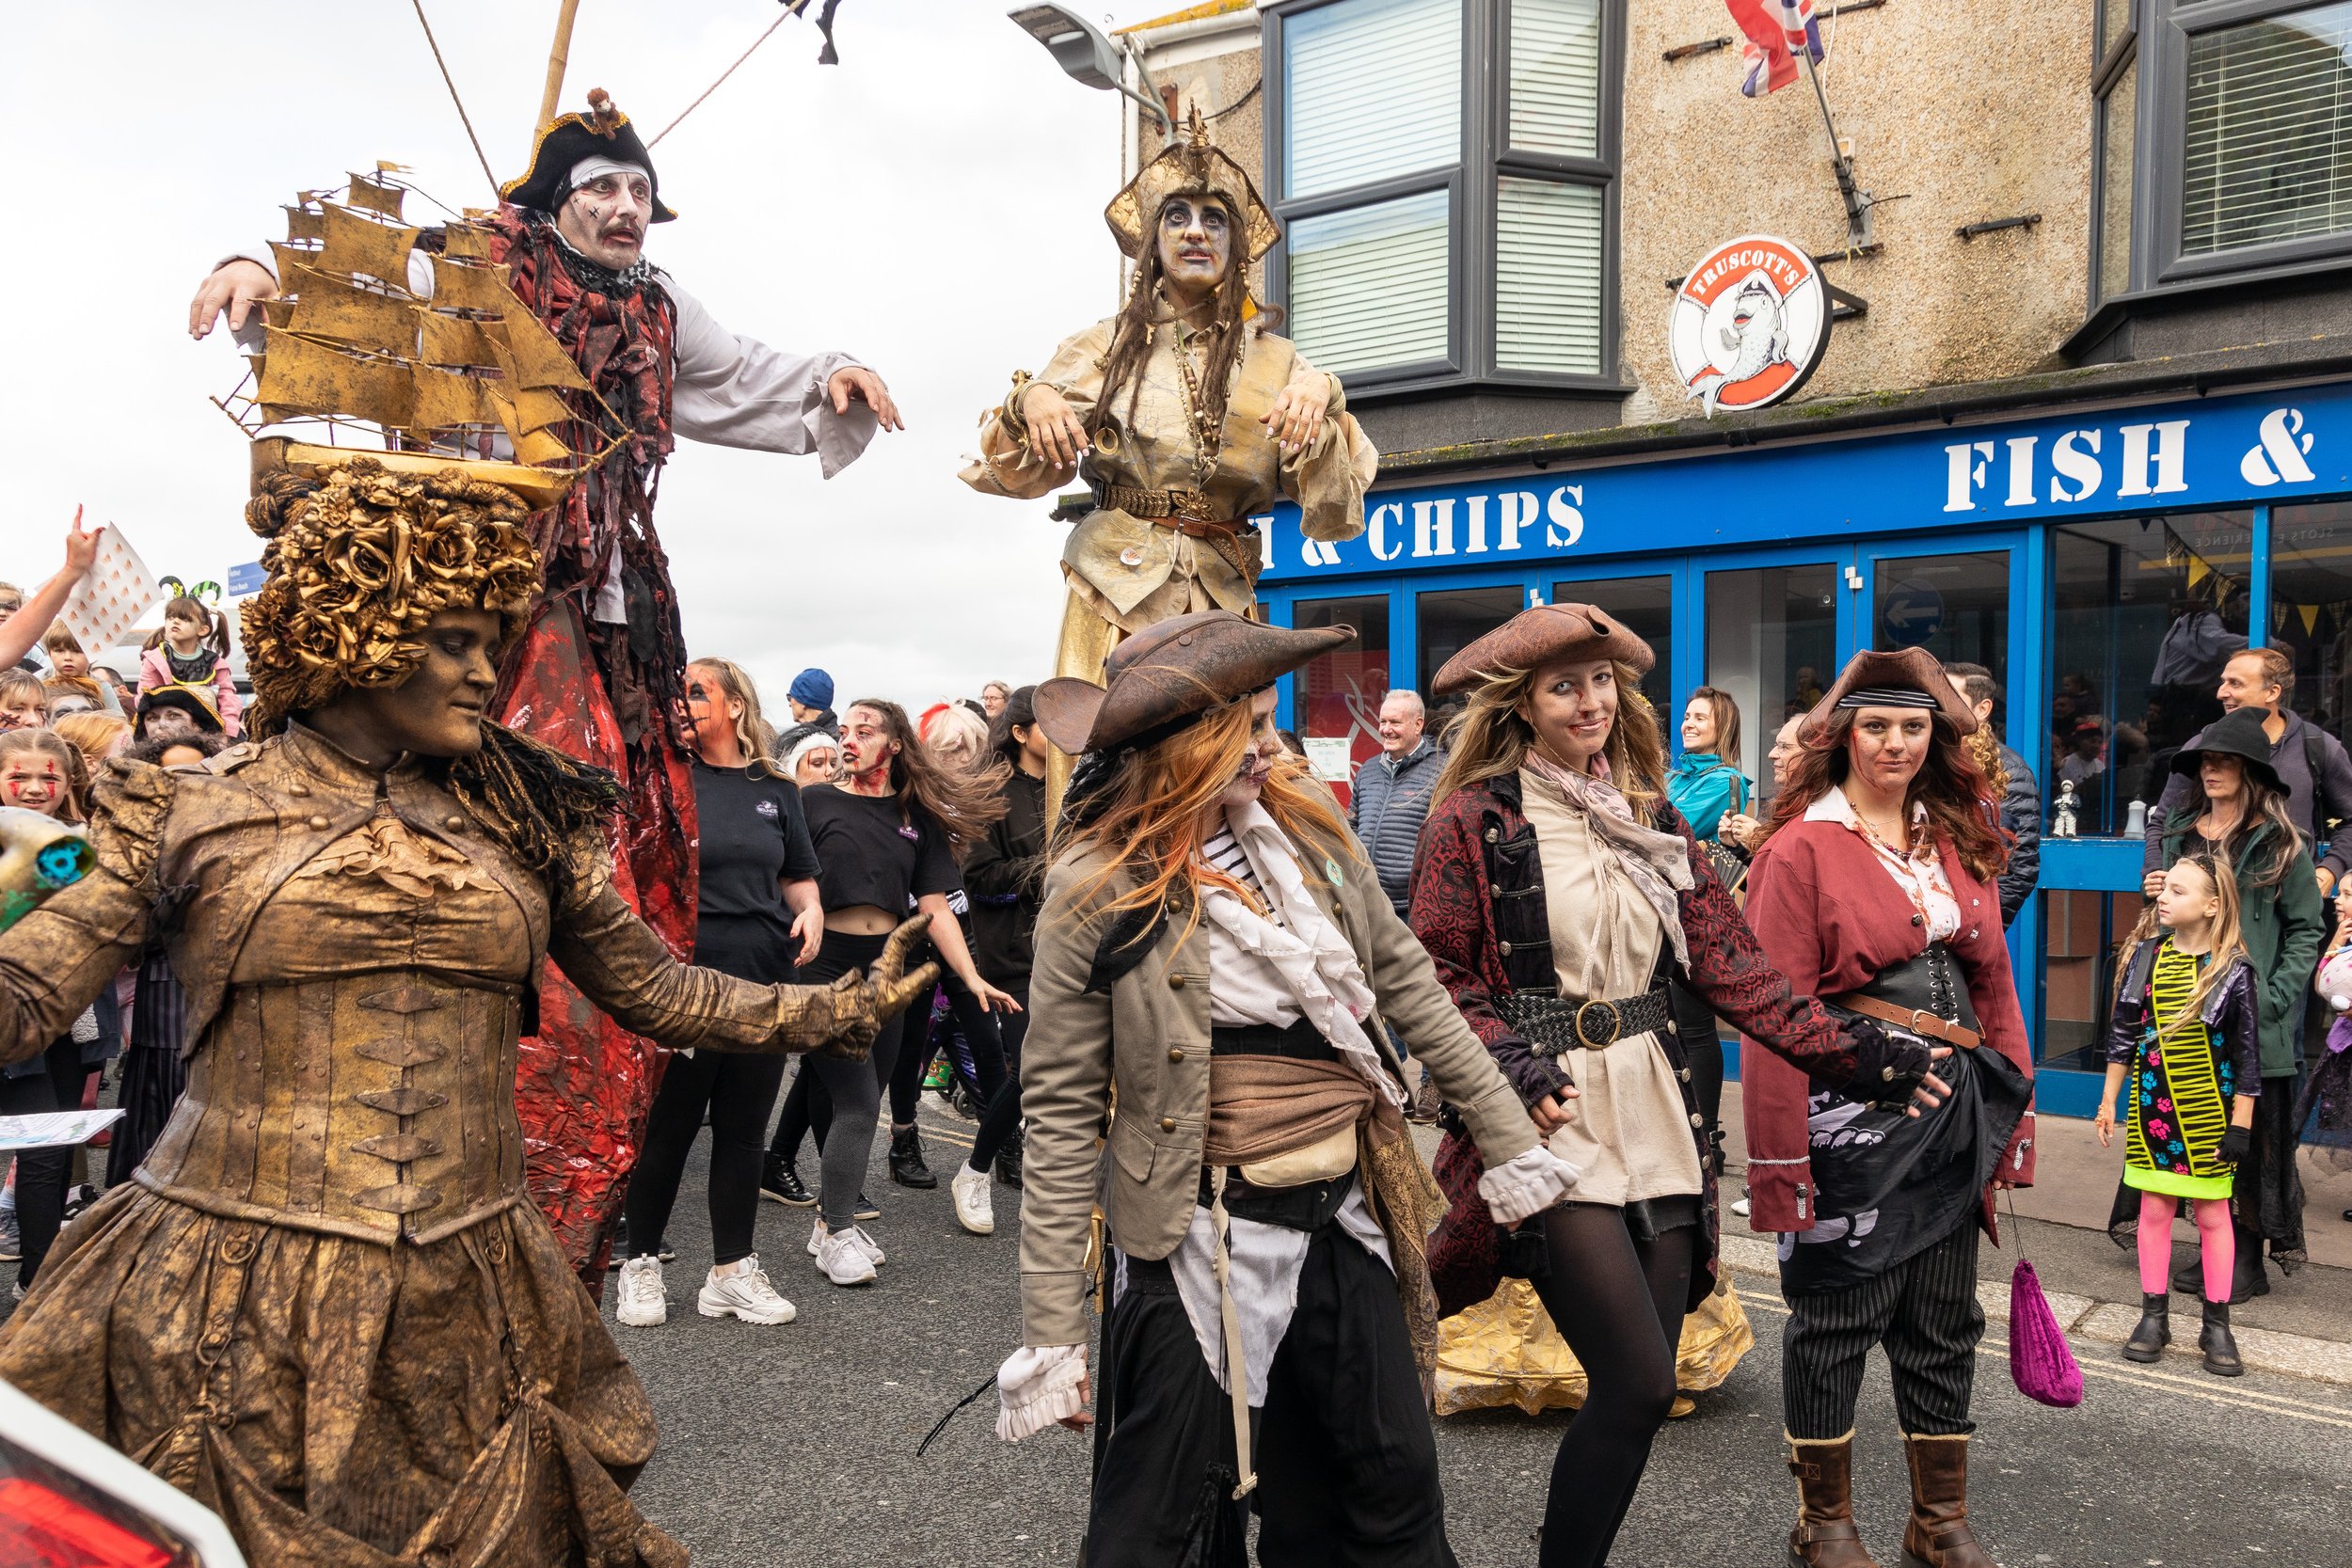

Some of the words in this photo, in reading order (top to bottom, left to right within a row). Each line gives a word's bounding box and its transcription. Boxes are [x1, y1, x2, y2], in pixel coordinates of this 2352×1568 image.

[1692, 249, 1800, 295] TRUSCOTT'S
[1943, 420, 2191, 513] FISH
[2240, 407, 2316, 486] &
[1367, 484, 1584, 562] CHIPS
